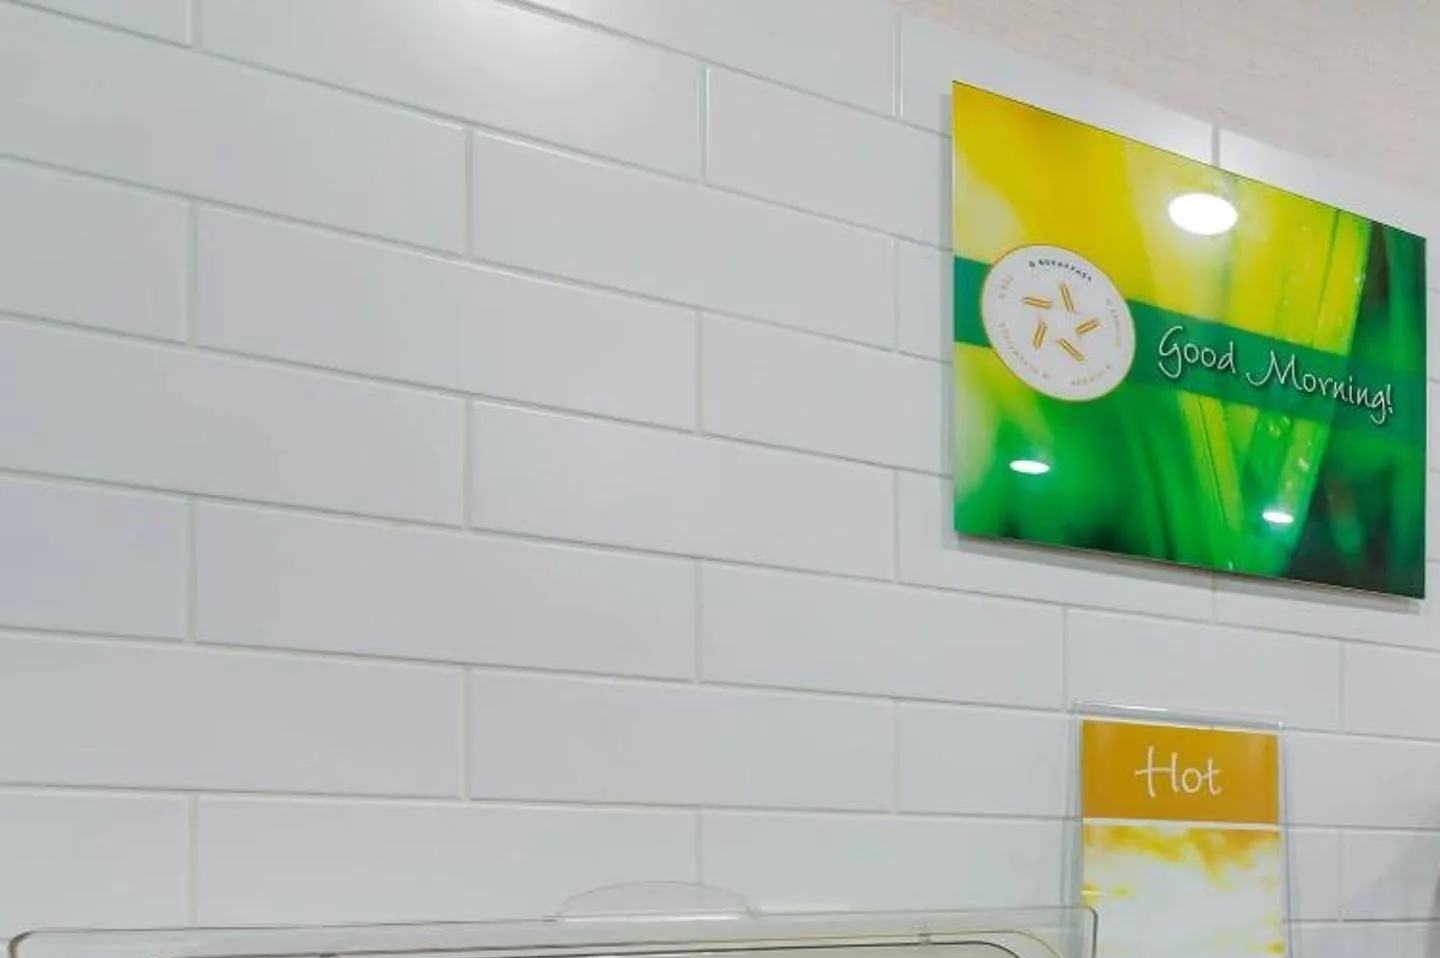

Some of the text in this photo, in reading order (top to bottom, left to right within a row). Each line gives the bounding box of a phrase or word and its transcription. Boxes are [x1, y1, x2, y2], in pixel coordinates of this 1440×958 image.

[1157, 325, 1394, 425] Good Morning!
[1134, 744, 1222, 799] Hot
